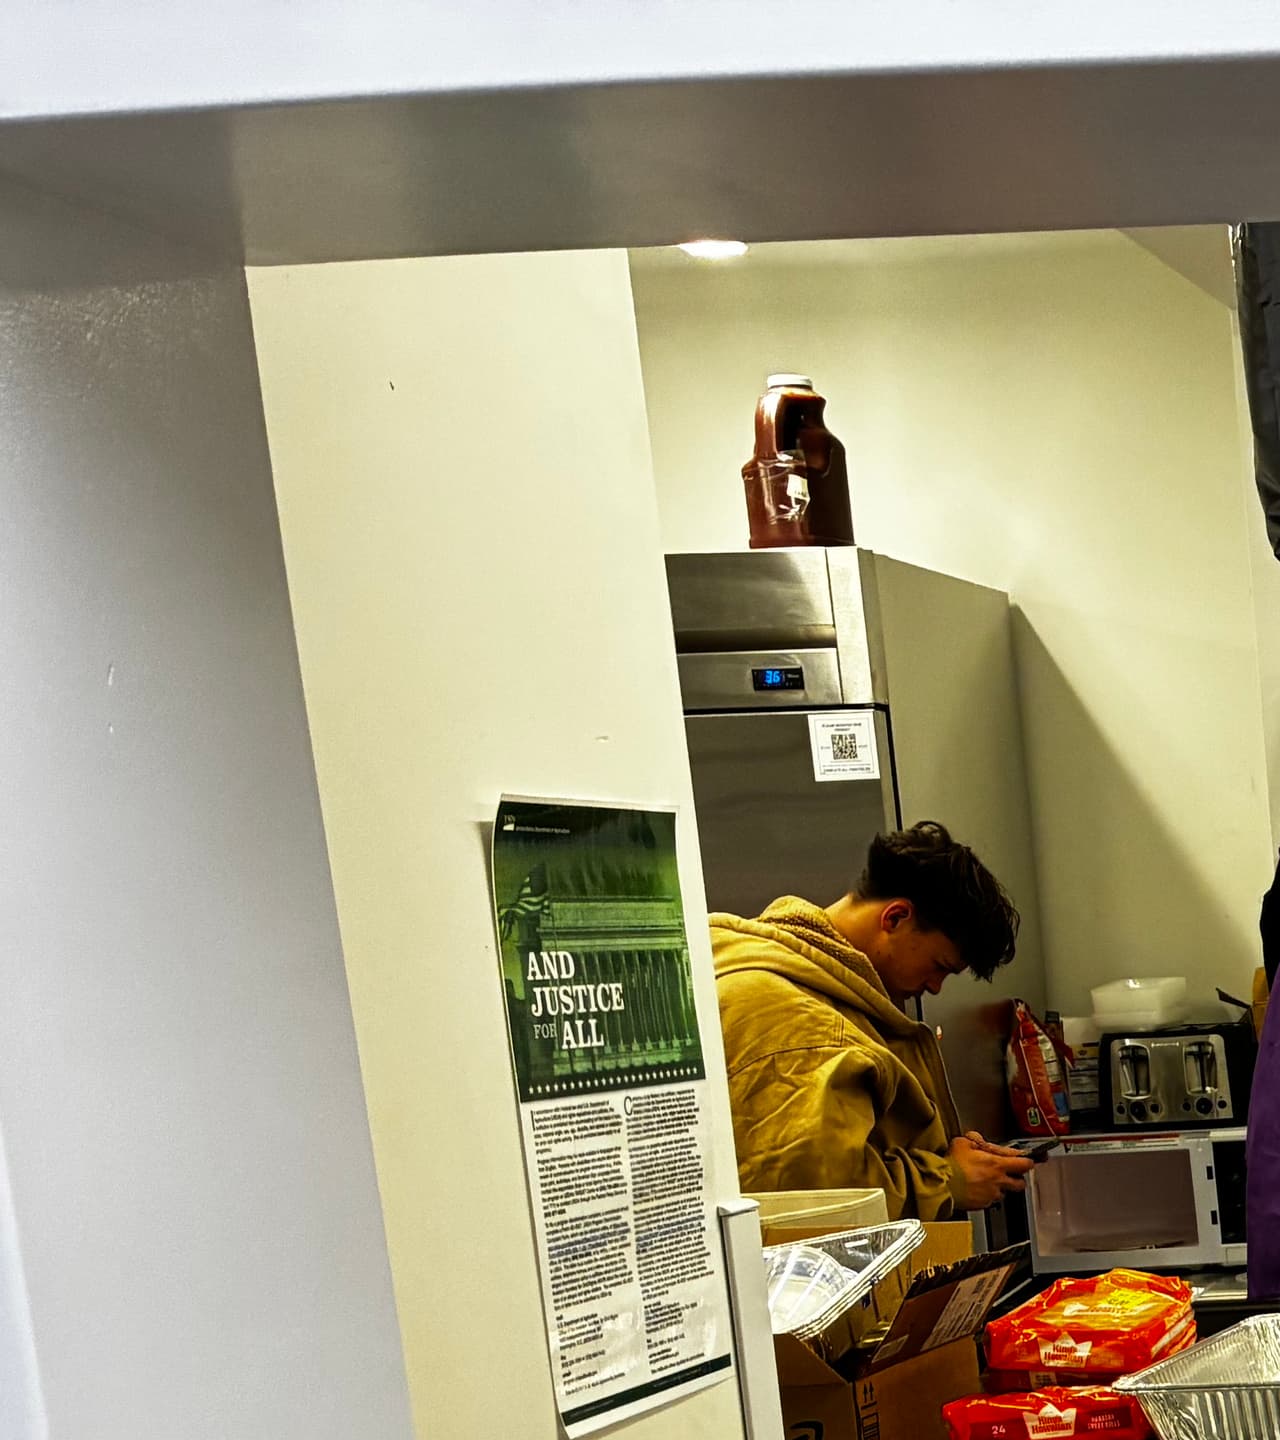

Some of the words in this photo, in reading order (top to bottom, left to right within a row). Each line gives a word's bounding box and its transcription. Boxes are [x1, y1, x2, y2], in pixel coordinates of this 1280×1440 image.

[527, 951, 575, 980] AND
[531, 983, 625, 1017] JUSTICE
[533, 1023, 558, 1039] FOR
[562, 1019, 605, 1049] ALL
[992, 1424, 1006, 1435] 24
